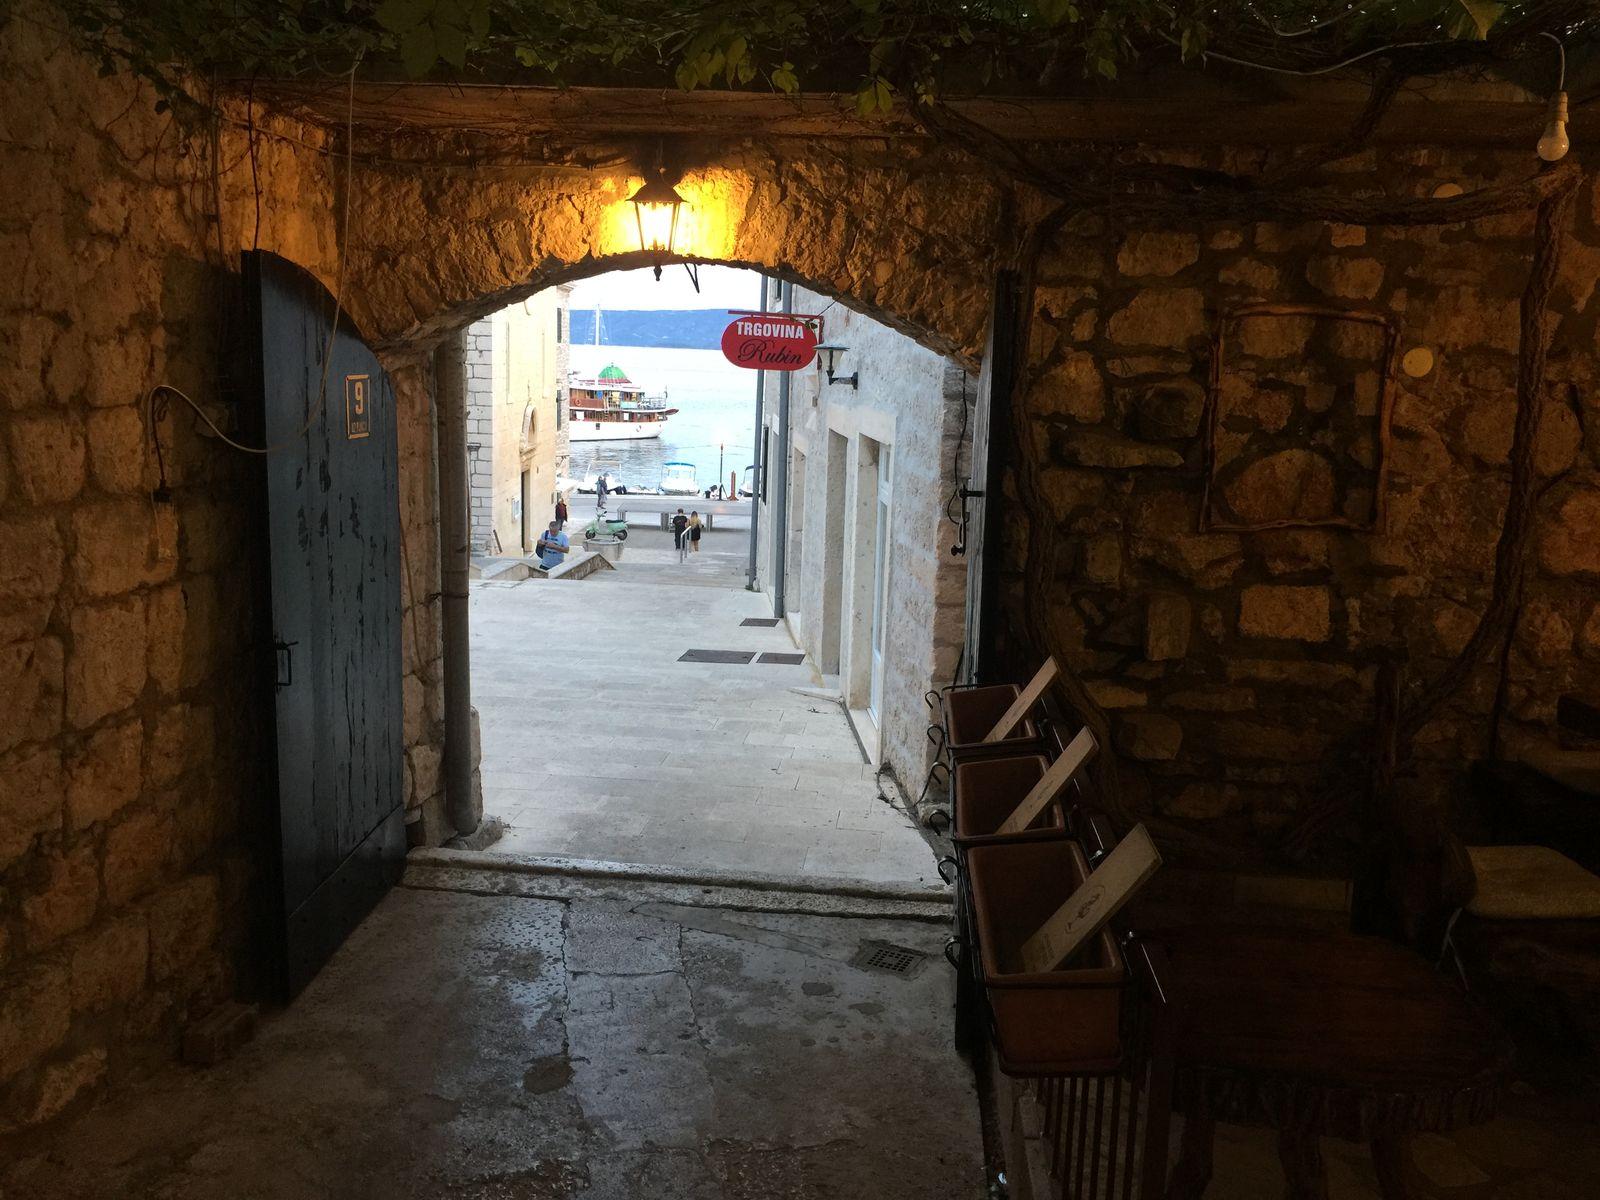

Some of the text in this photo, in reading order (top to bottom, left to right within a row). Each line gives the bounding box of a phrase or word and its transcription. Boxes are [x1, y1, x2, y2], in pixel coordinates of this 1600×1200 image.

[736, 321, 804, 340] TRGOVINA
[737, 338, 803, 365] Rubin
[354, 381, 364, 415] 9
